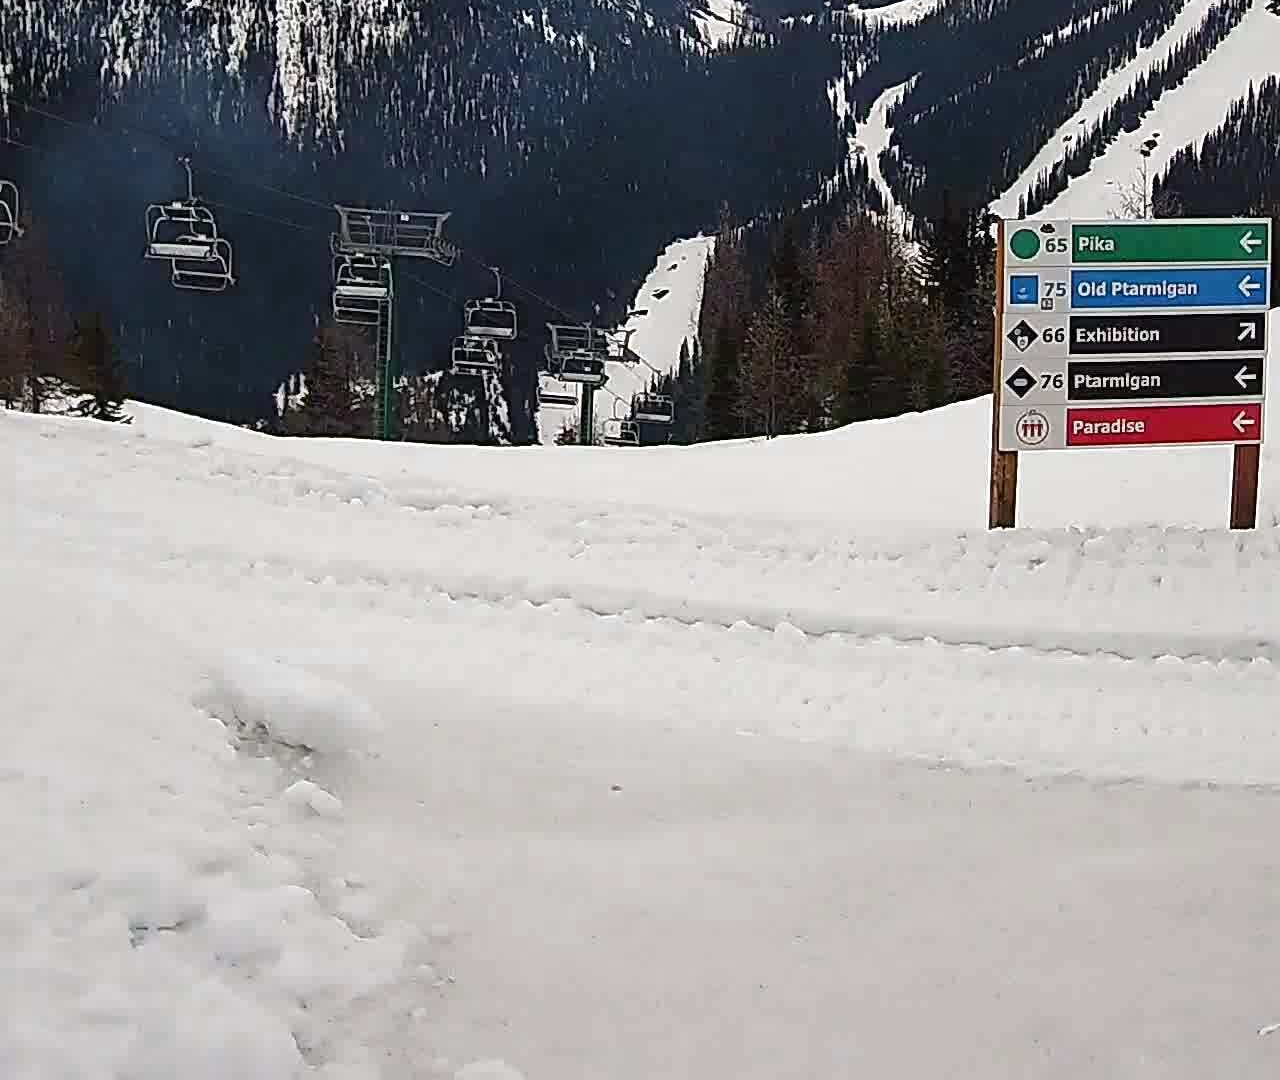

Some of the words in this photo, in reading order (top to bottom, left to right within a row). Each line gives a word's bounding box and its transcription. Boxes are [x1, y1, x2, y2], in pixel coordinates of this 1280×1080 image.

[1045, 237, 1068, 253] 65
[1078, 236, 1115, 252] Pika
[1044, 282, 1067, 297] 75
[1077, 281, 1106, 297] Old
[1112, 281, 1198, 299] Ptarmigan
[1042, 327, 1065, 343] 66
[1076, 327, 1160, 343] Exhibition
[1040, 373, 1064, 390] 76
[1074, 373, 1161, 391] Ptarmigan
[1073, 419, 1145, 434] Paradise
